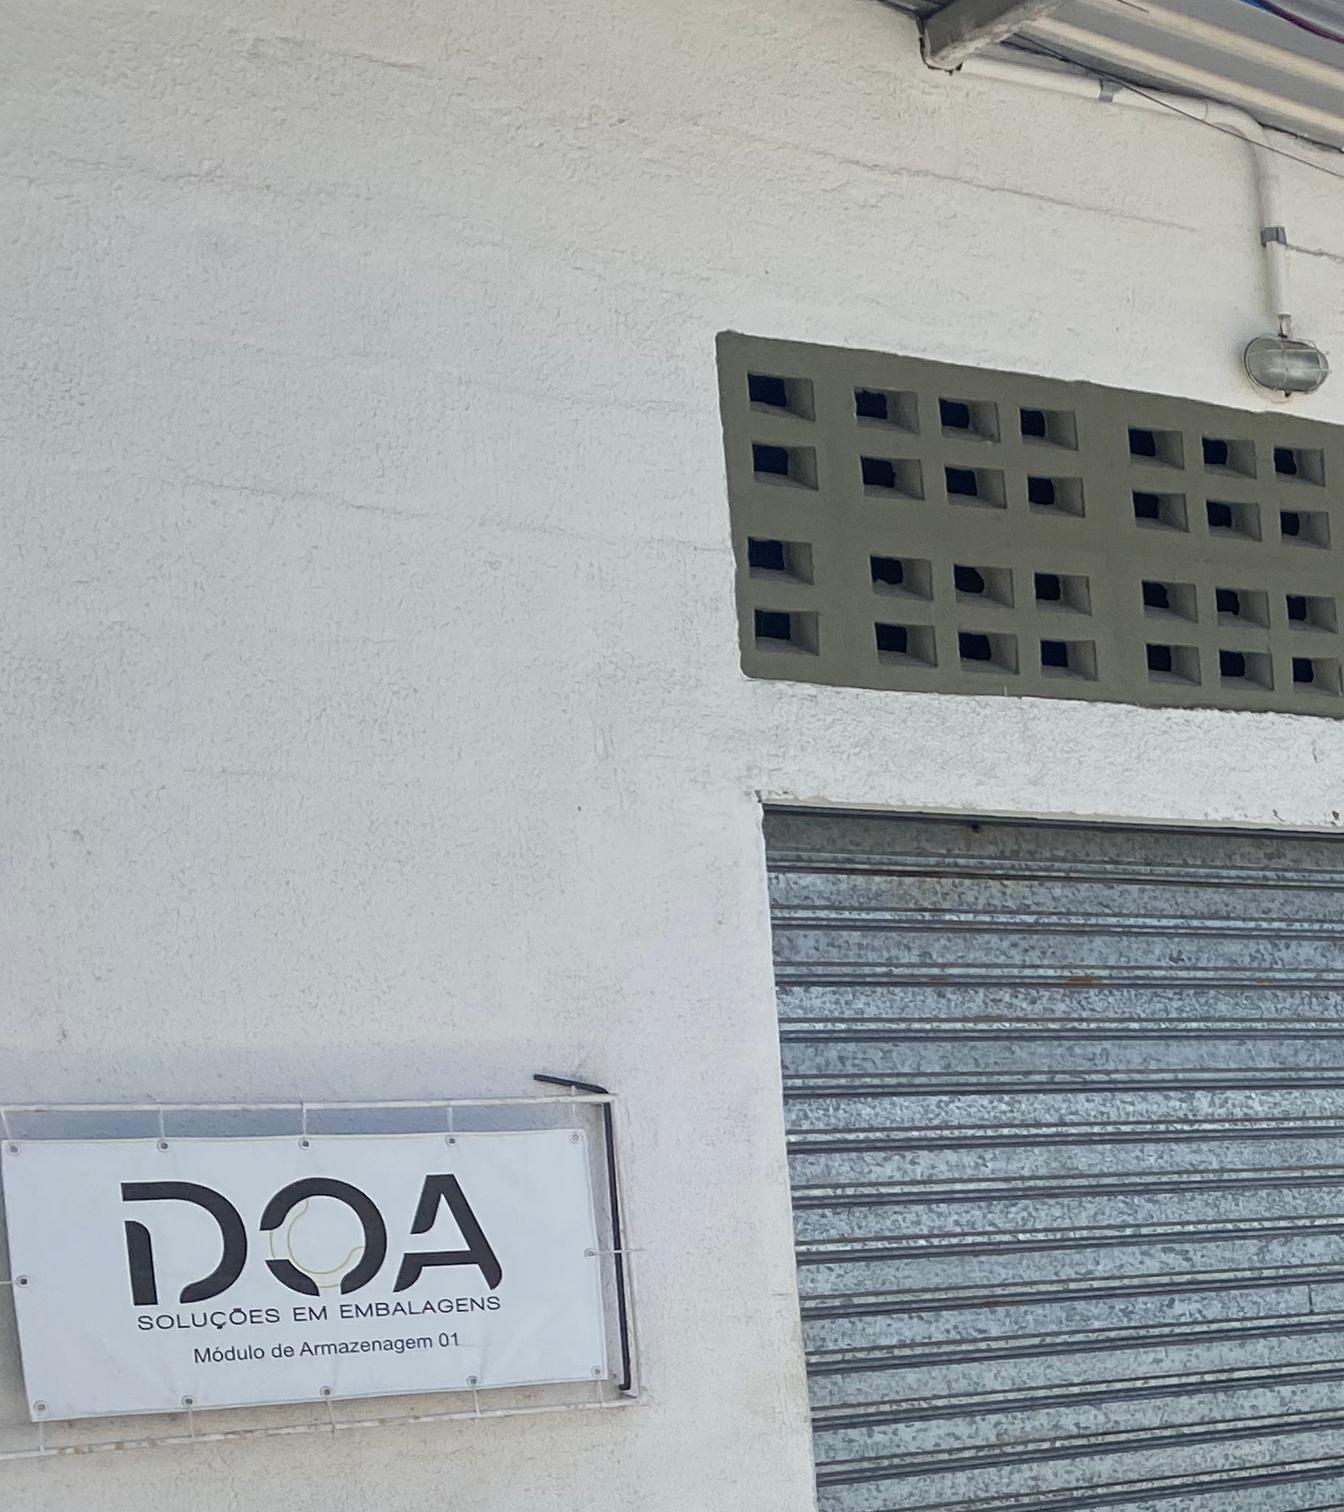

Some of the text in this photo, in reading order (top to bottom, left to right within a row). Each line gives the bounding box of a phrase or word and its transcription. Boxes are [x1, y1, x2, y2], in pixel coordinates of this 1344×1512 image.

[121, 1174, 502, 1306] DOA
[137, 1295, 501, 1330] SOLUÇÕES EM EMBALAGENS
[193, 1332, 460, 1364] Módulo de Armazenagem 01
